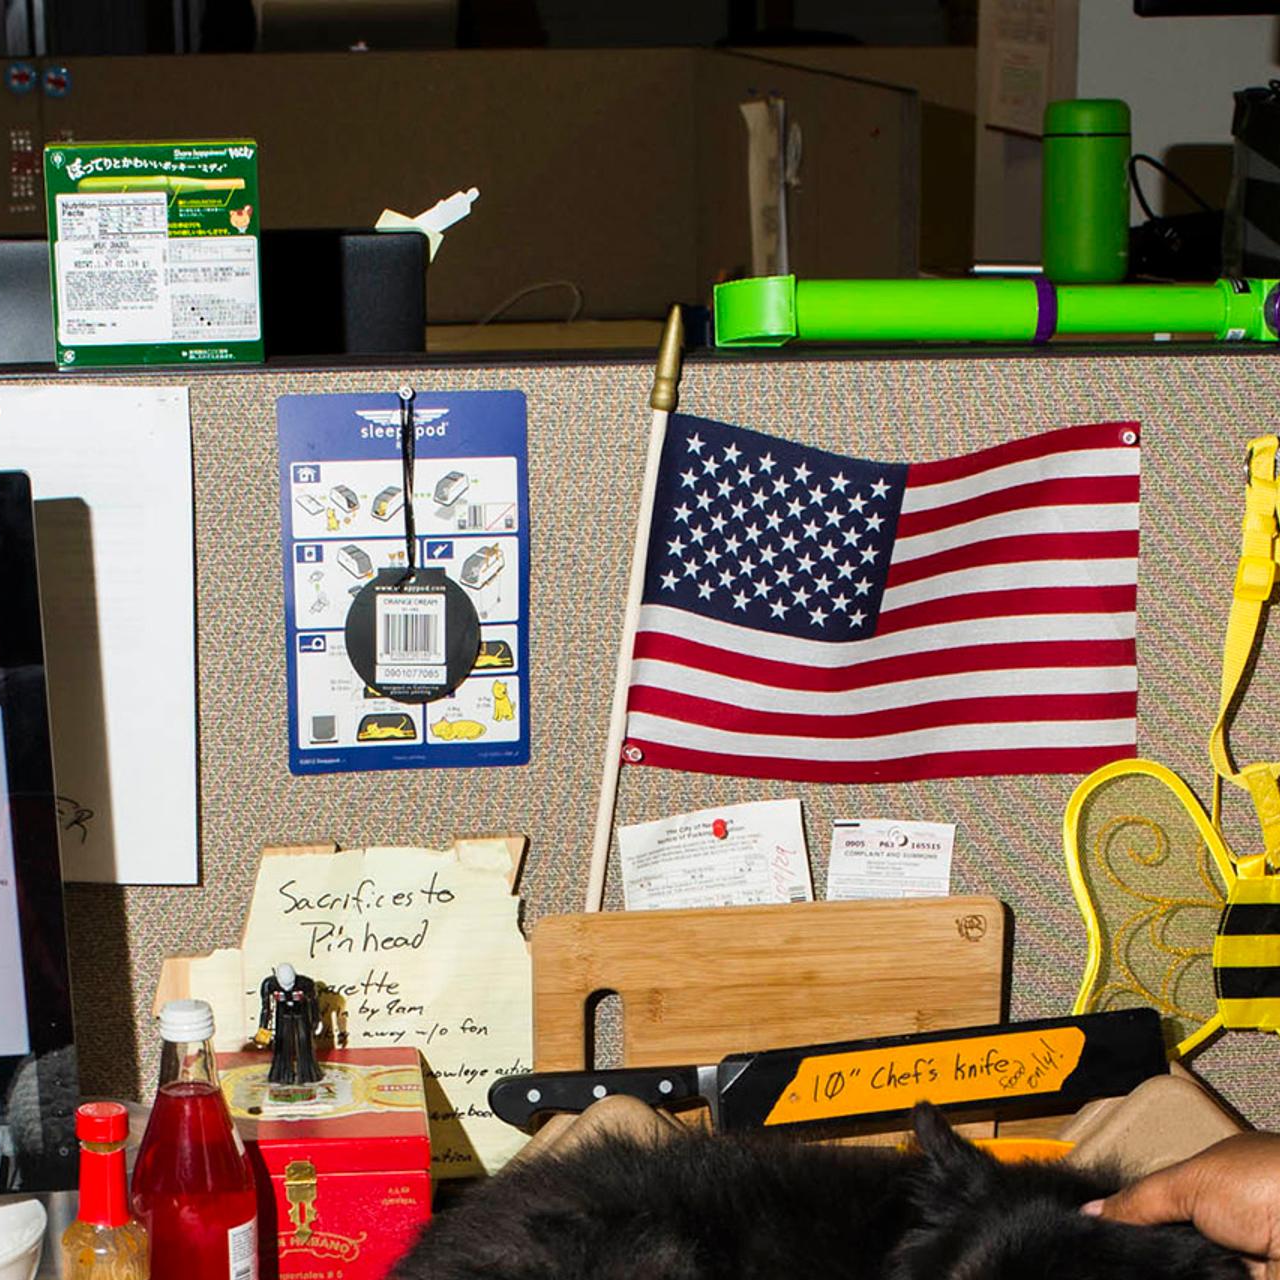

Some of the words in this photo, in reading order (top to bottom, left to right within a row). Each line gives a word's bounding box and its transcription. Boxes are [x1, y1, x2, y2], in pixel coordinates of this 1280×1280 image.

[361, 422, 446, 441] sleeppod
[845, 840, 866, 848] 0905
[844, 850, 885, 858] COMPLAINT
[886, 851, 900, 859] AND
[279, 879, 414, 914] Sacrifices
[420, 871, 456, 904] to
[358, 1000, 381, 1021] by
[870, 1057, 938, 1090] Chef's
[954, 1048, 1010, 1081] knife
